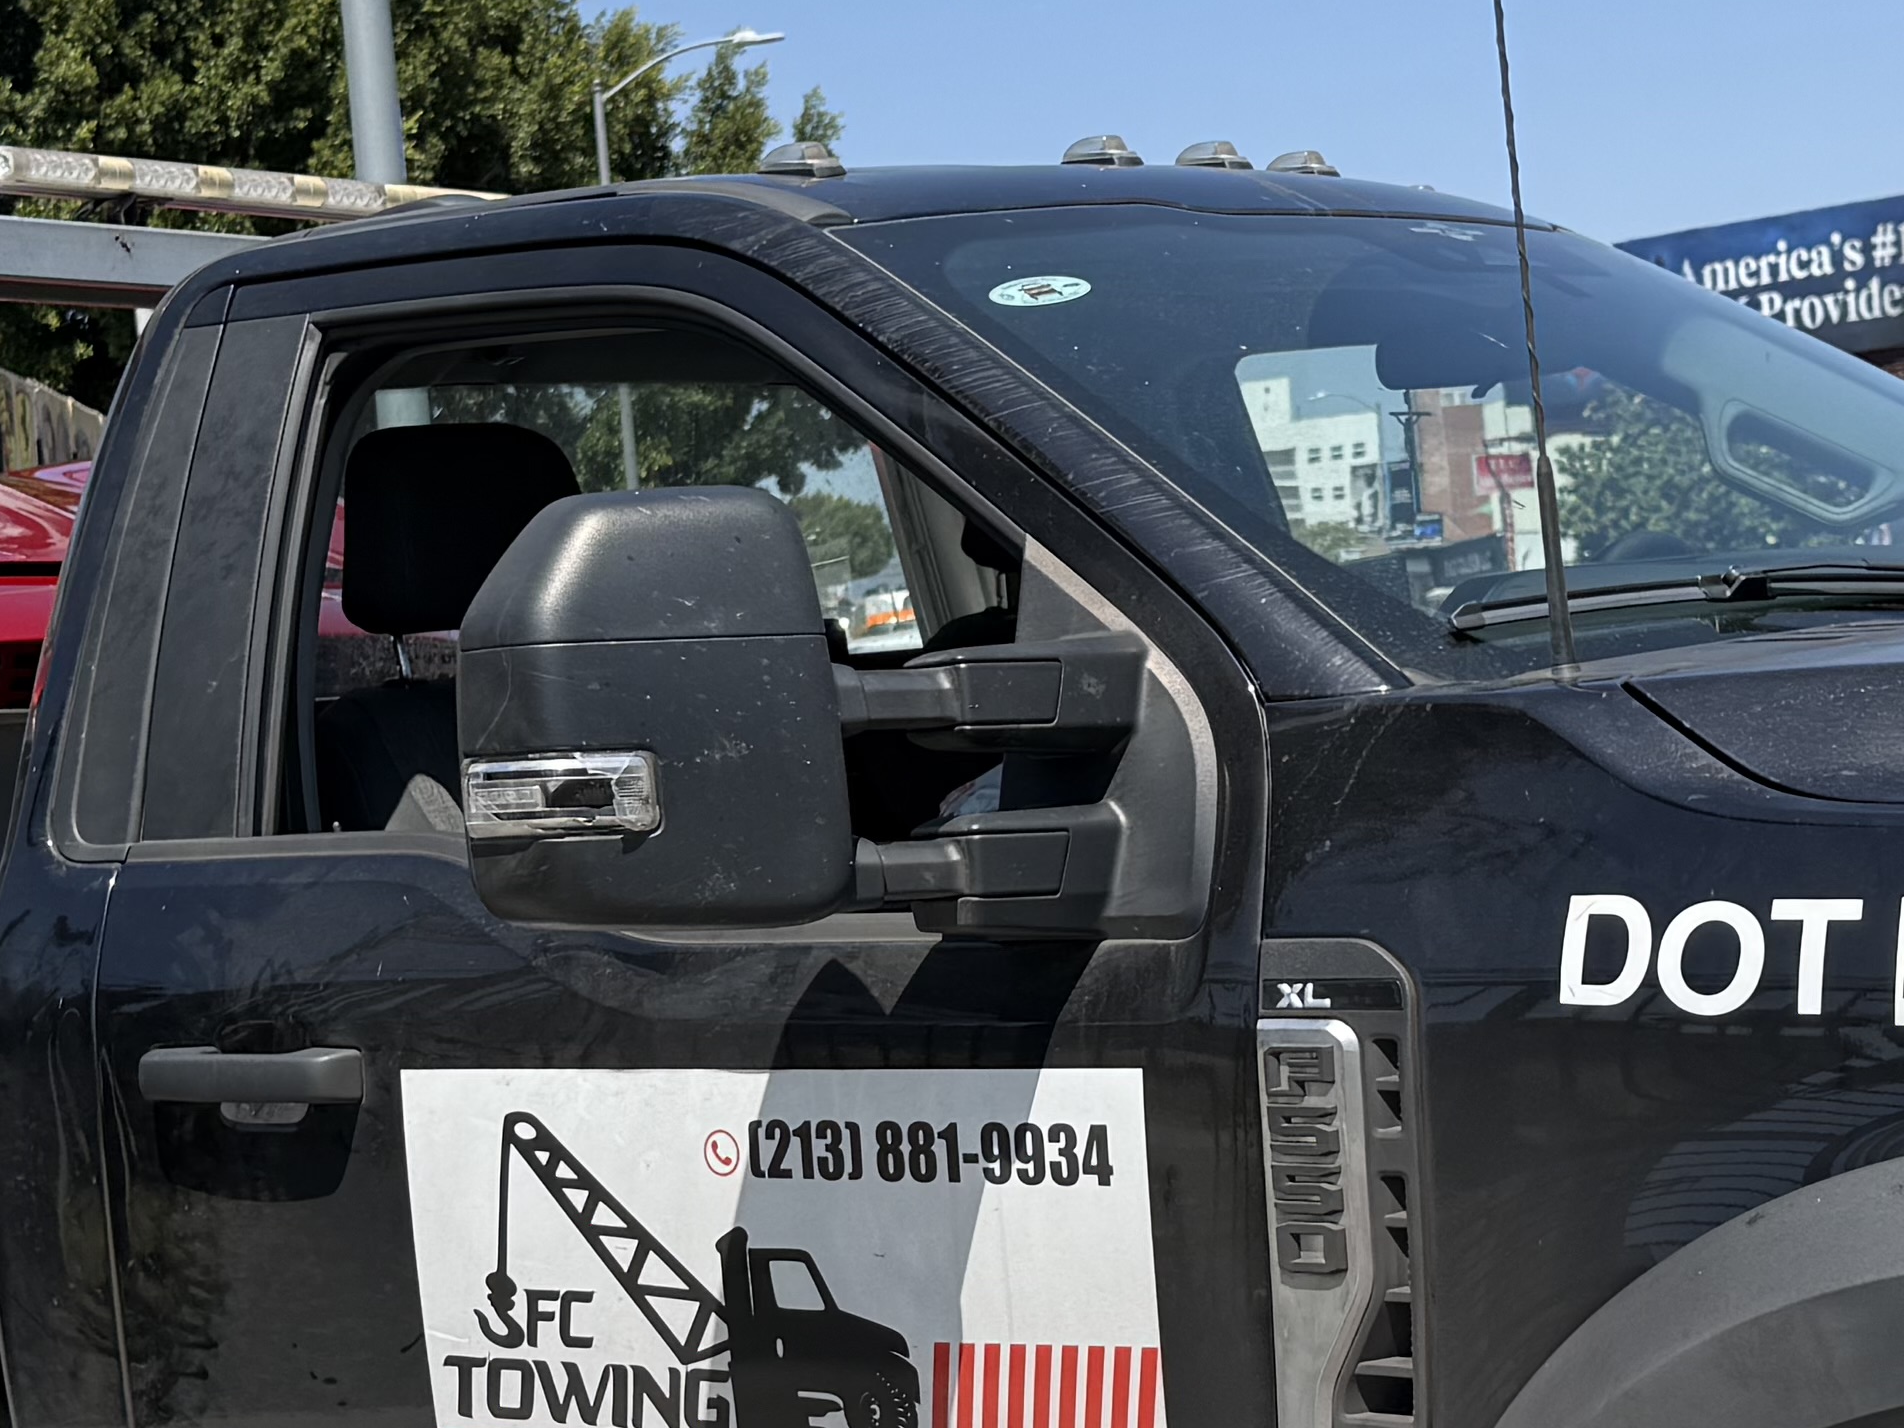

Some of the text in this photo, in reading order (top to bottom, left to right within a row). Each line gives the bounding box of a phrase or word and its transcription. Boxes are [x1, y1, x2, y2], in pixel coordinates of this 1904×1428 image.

[1560, 893, 1863, 1015] DOT
[1276, 982, 1332, 1009] XL
[748, 1118, 1114, 1188] (213) 881-9934
